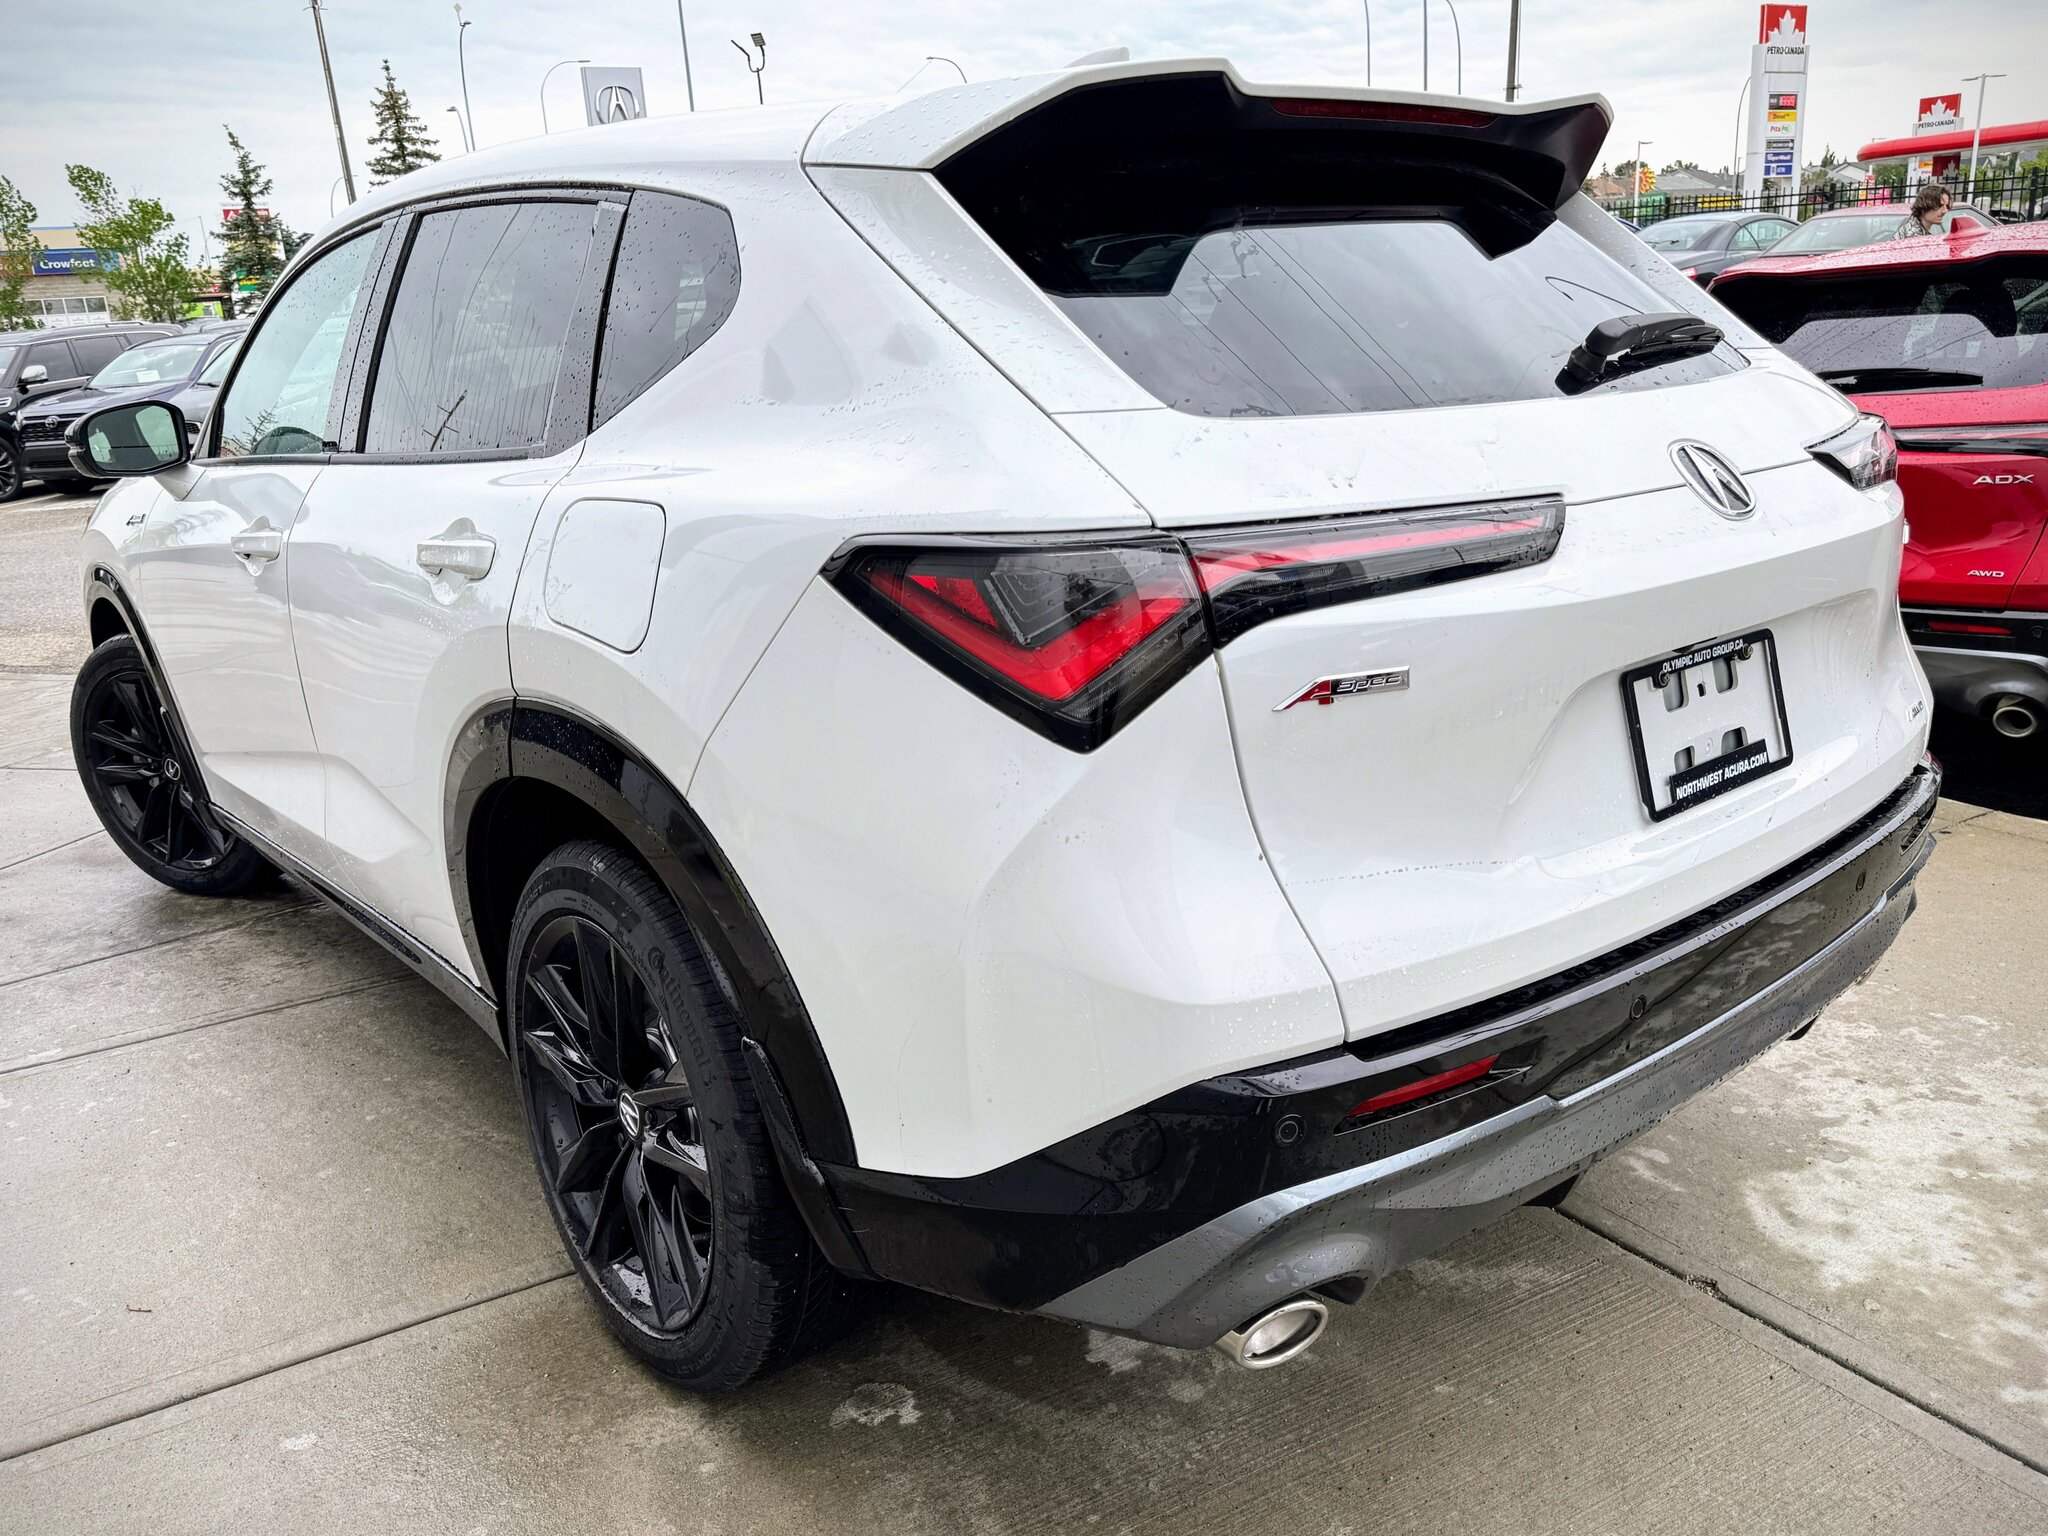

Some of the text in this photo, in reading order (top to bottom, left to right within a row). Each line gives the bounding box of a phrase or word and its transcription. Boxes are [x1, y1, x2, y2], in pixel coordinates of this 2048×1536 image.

[1972, 474, 2035, 485] ADX
[1967, 569, 2005, 578] AWD
[1662, 639, 1744, 673] OLYMPIC AUTO GROUP.CA
[1675, 751, 1768, 801] NORTHWEST ACURA.COM
[648, 946, 713, 1069] Continental
